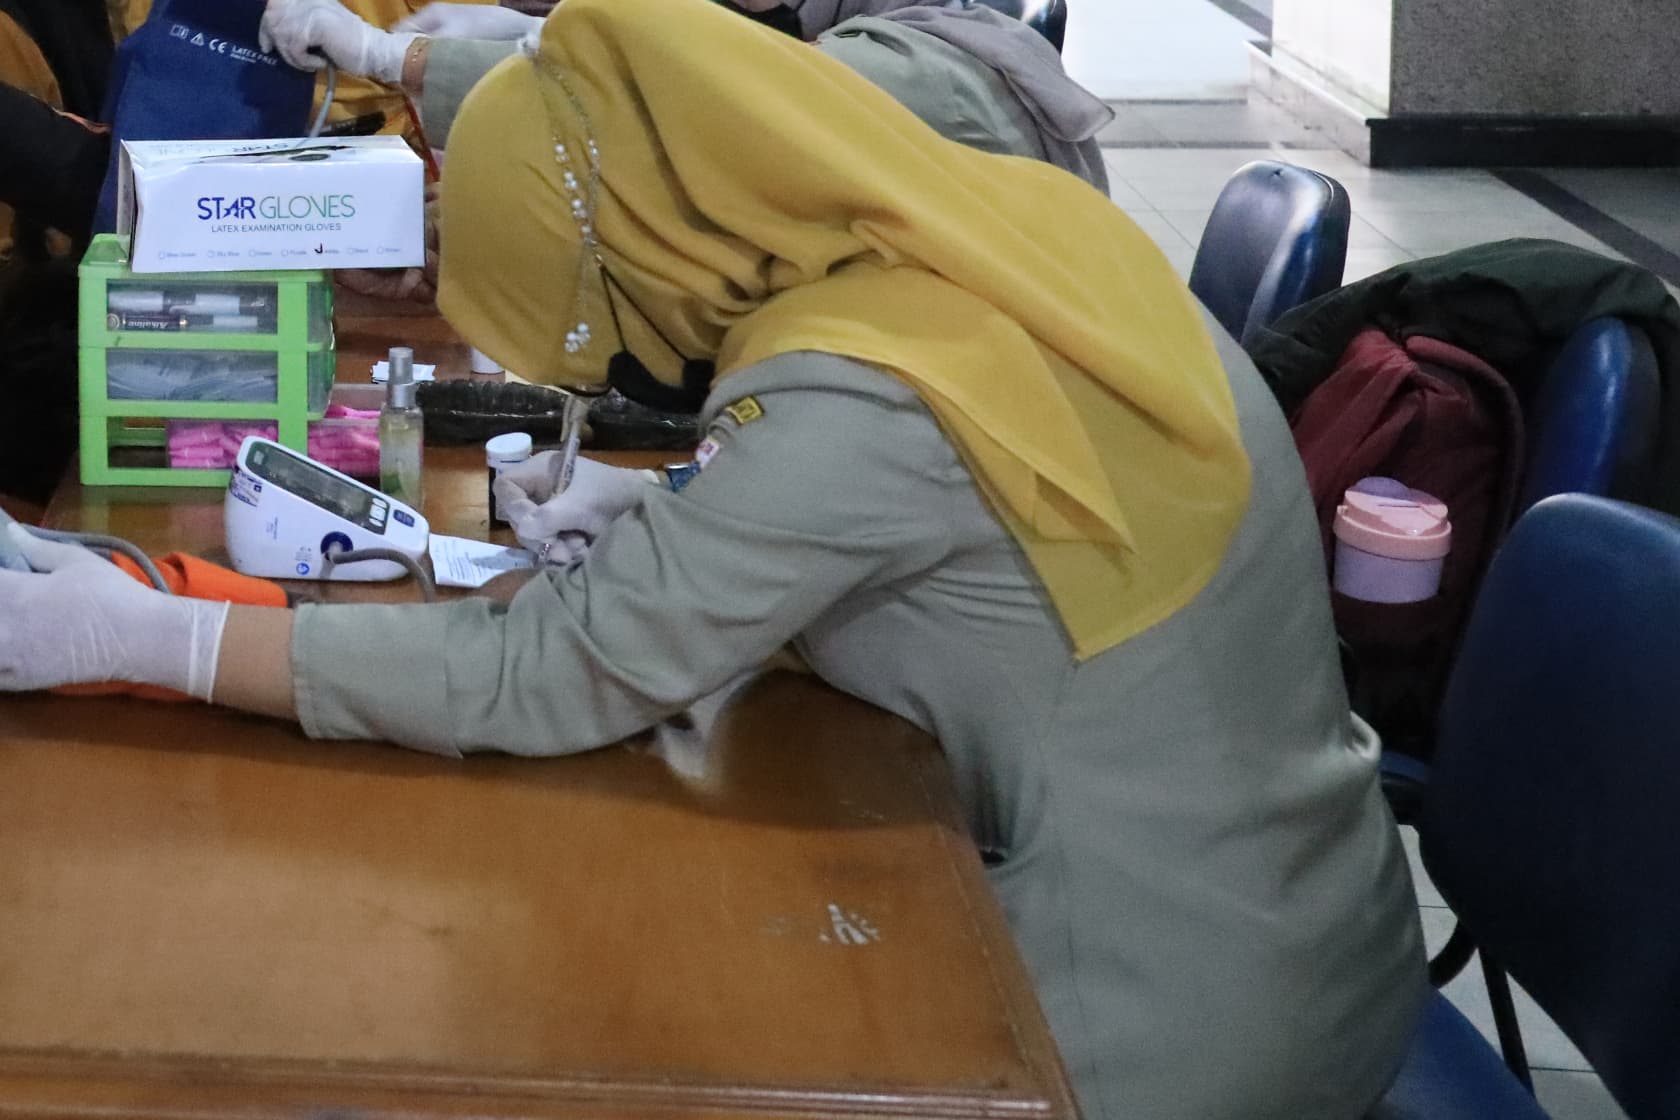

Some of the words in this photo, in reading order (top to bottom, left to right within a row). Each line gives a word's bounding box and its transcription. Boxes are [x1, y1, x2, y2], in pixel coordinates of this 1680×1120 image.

[231, 44, 257, 58] LATEX
[211, 224, 240, 233] LATEX
[241, 223, 303, 233] EXAMINATION
[304, 222, 342, 232] GLOVES
